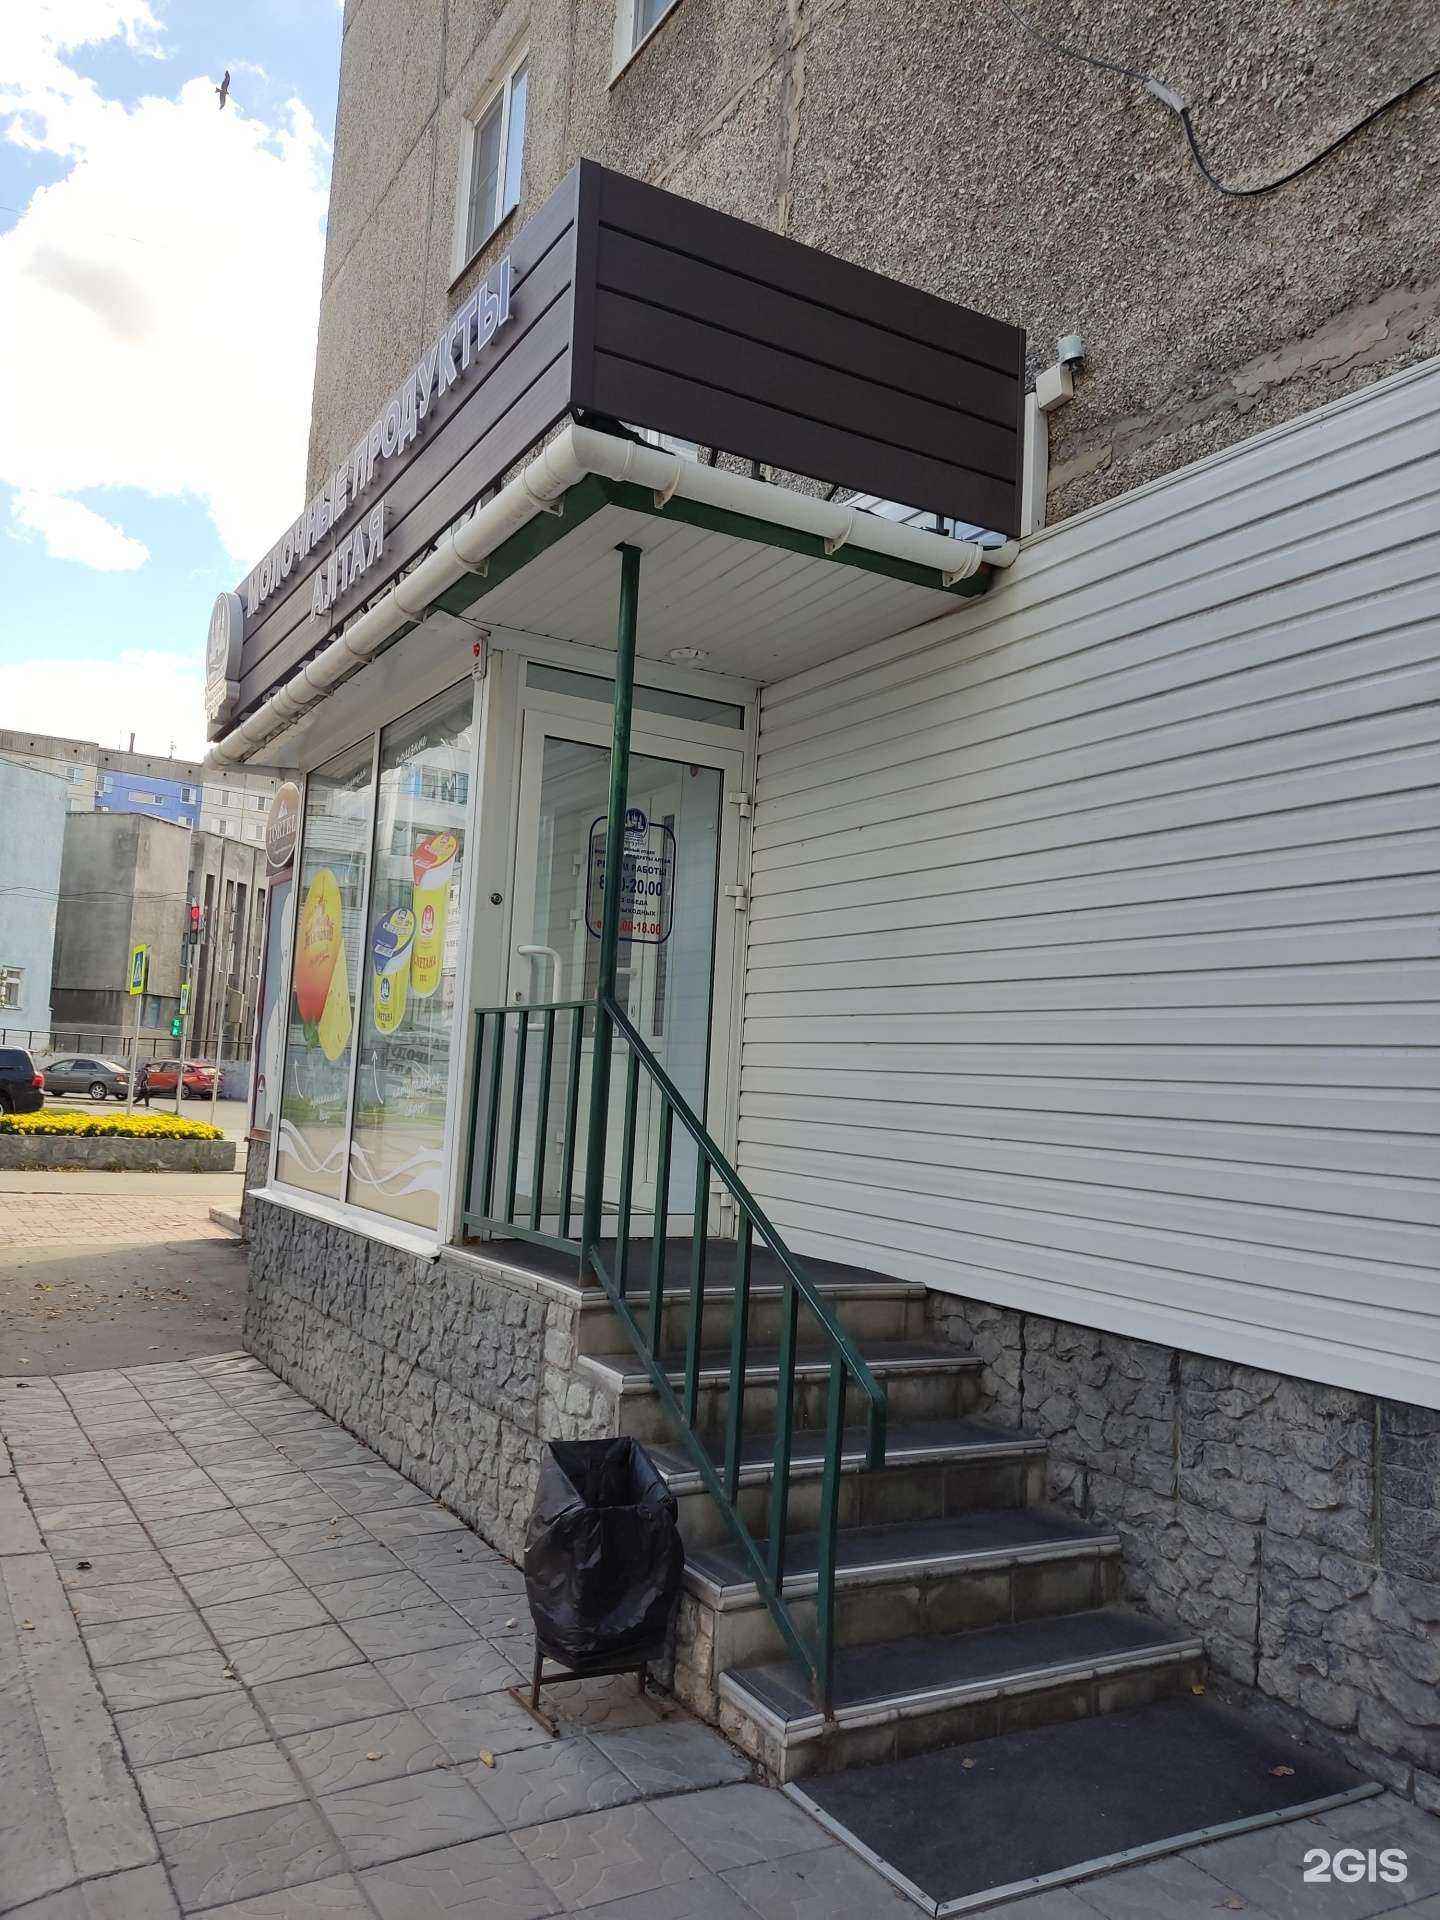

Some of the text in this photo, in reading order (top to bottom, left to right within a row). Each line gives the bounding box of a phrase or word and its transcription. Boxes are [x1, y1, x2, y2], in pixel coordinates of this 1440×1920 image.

[246, 255, 512, 619] МОЛОЧНЫЕ ПРОДУКТЫ
[309, 500, 386, 624] АЛТАЯ
[631, 864, 667, 877] РАБОТЫ
[621, 908, 656, 917] ЫХОДНЫХ
